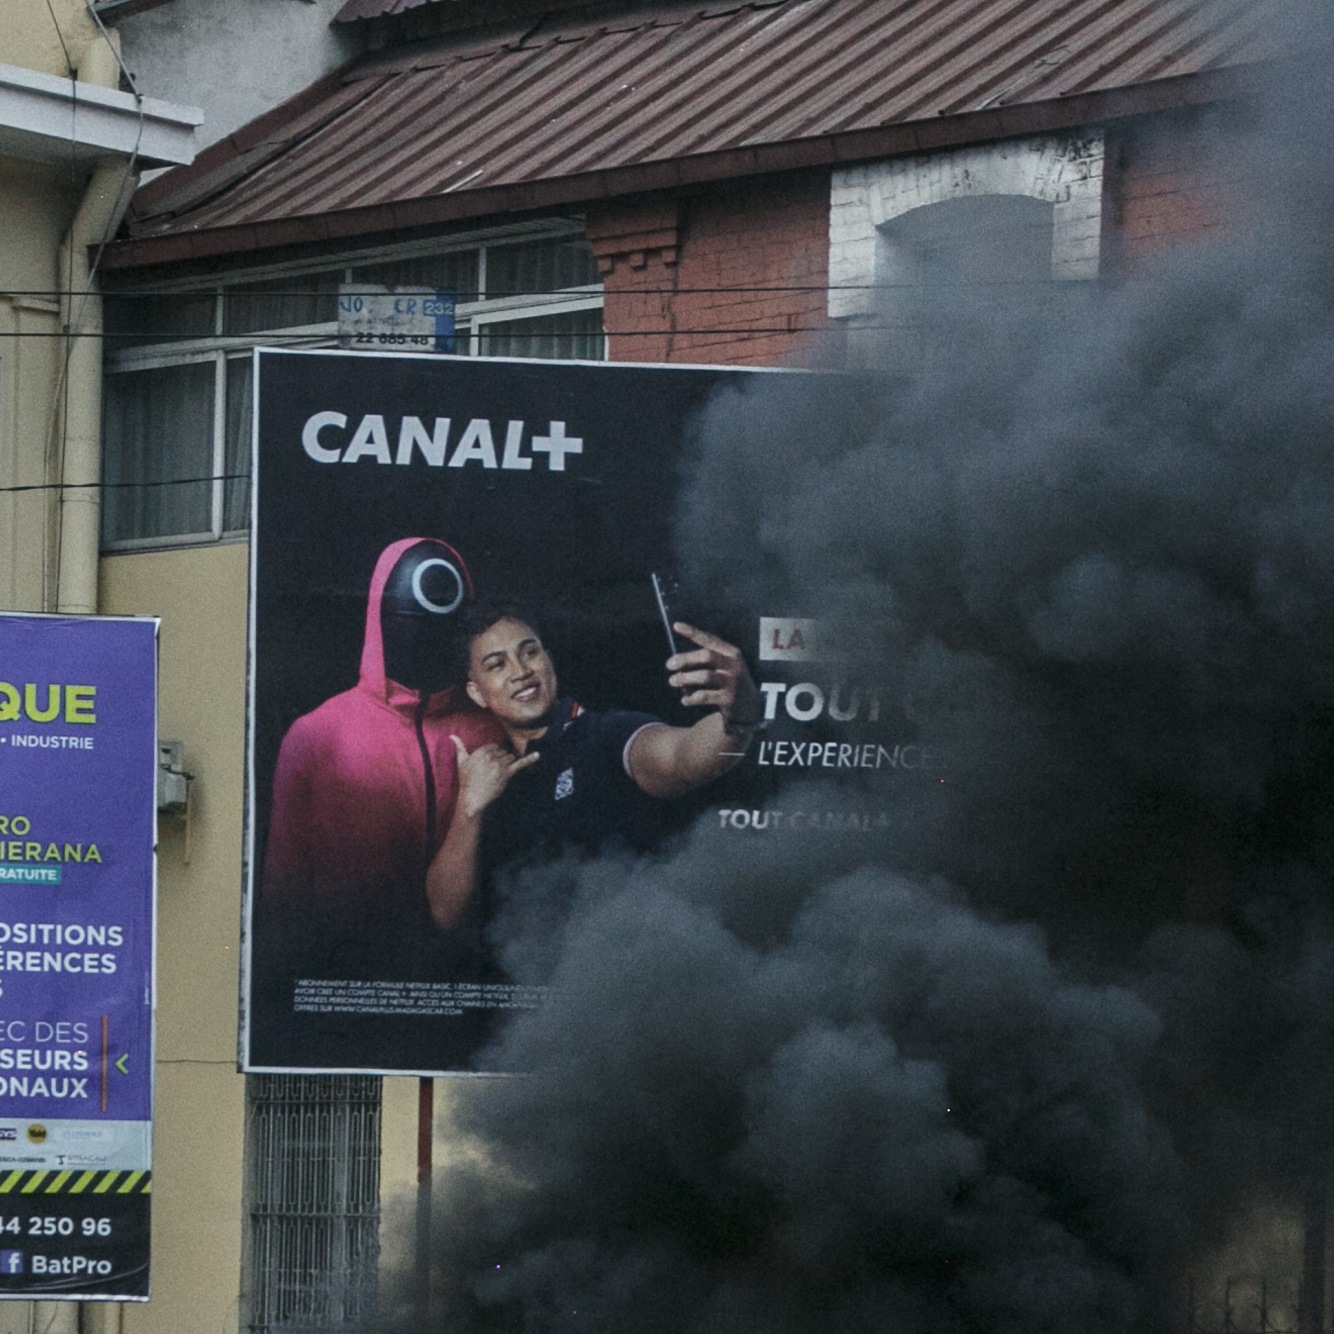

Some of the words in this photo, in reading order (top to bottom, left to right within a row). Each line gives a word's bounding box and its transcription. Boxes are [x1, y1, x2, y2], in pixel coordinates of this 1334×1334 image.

[424, 302, 454, 316] 232
[411, 334, 429, 346] 48
[302, 410, 584, 471] CANAL+
[772, 629, 805, 650] LA
[11, 734, 94, 750] INDUSTRIE
[35, 1021, 89, 1043] DES
[28, 1217, 74, 1236] 250
[81, 1217, 112, 1236] 96
[31, 1255, 113, 1275] BatPro
